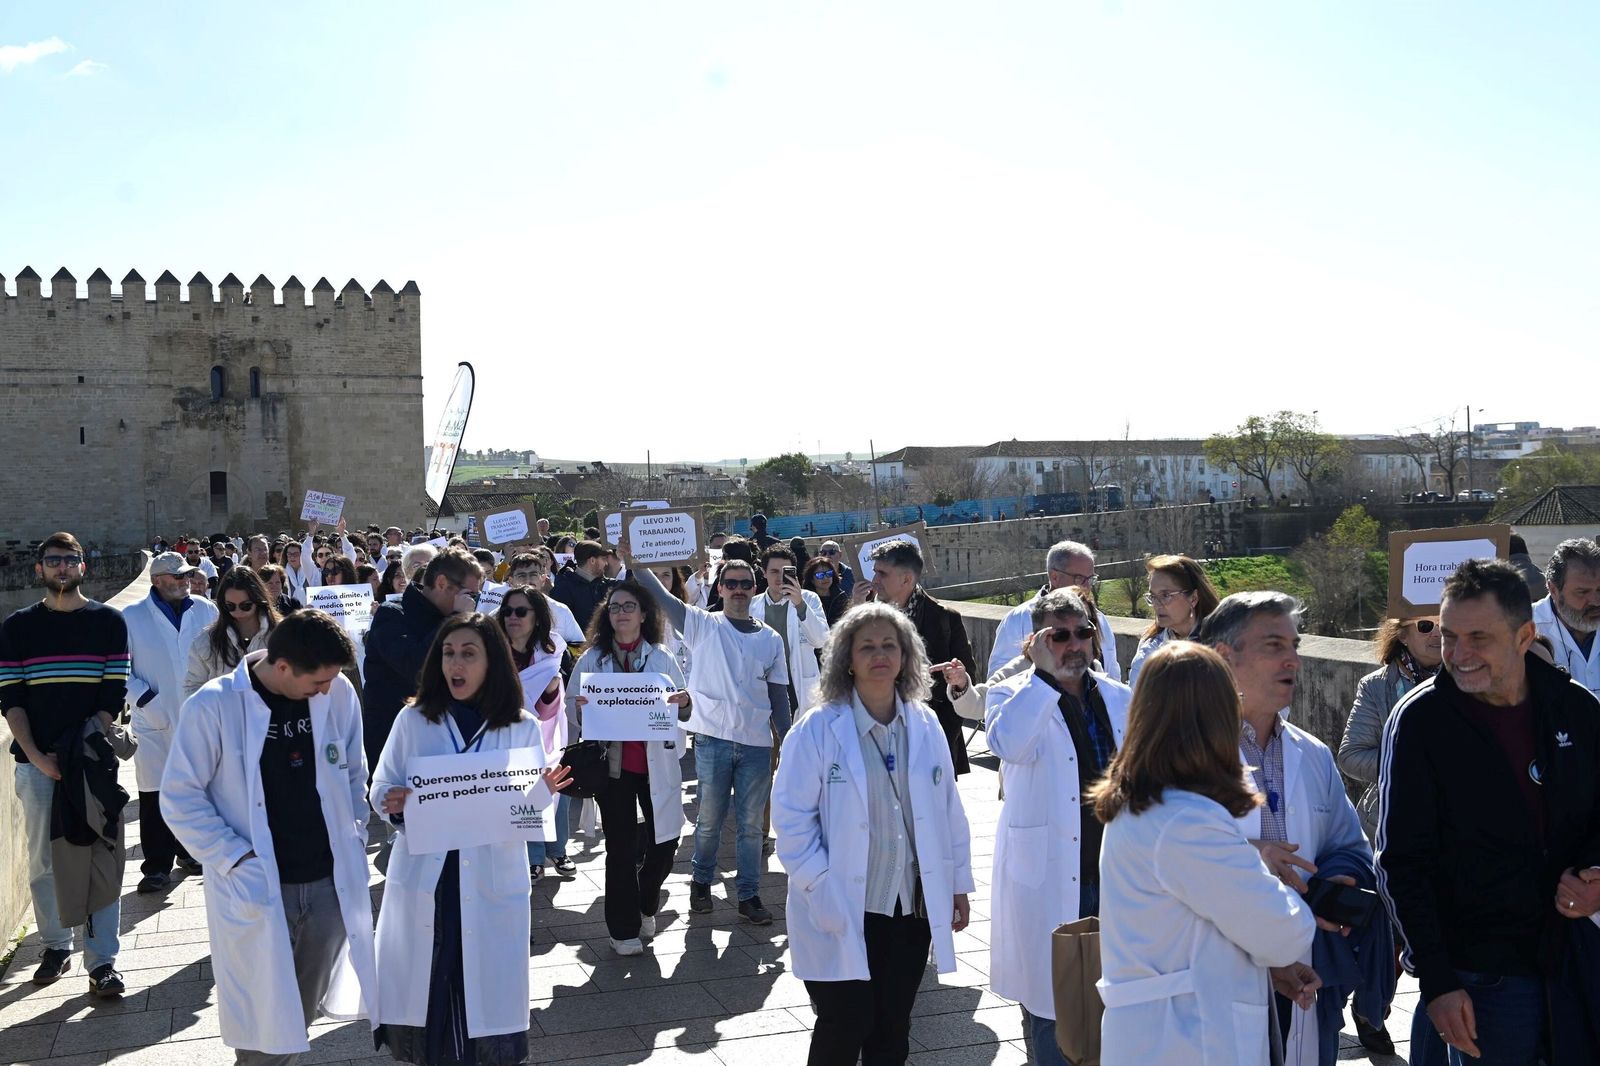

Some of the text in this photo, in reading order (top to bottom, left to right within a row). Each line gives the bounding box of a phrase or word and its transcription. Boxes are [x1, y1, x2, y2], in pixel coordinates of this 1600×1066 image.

[638, 527, 686, 536] TRABAJANDO,
[660, 549, 694, 558] anestesio?
[1415, 563, 1437, 572] Hora
[582, 685, 601, 693] “No
[617, 685, 662, 694] vocación,
[597, 697, 660, 707] explotación”
[408, 773, 477, 788] “Queremos
[418, 781, 534, 804] para poder curar”
[510, 804, 542, 816] SMA
